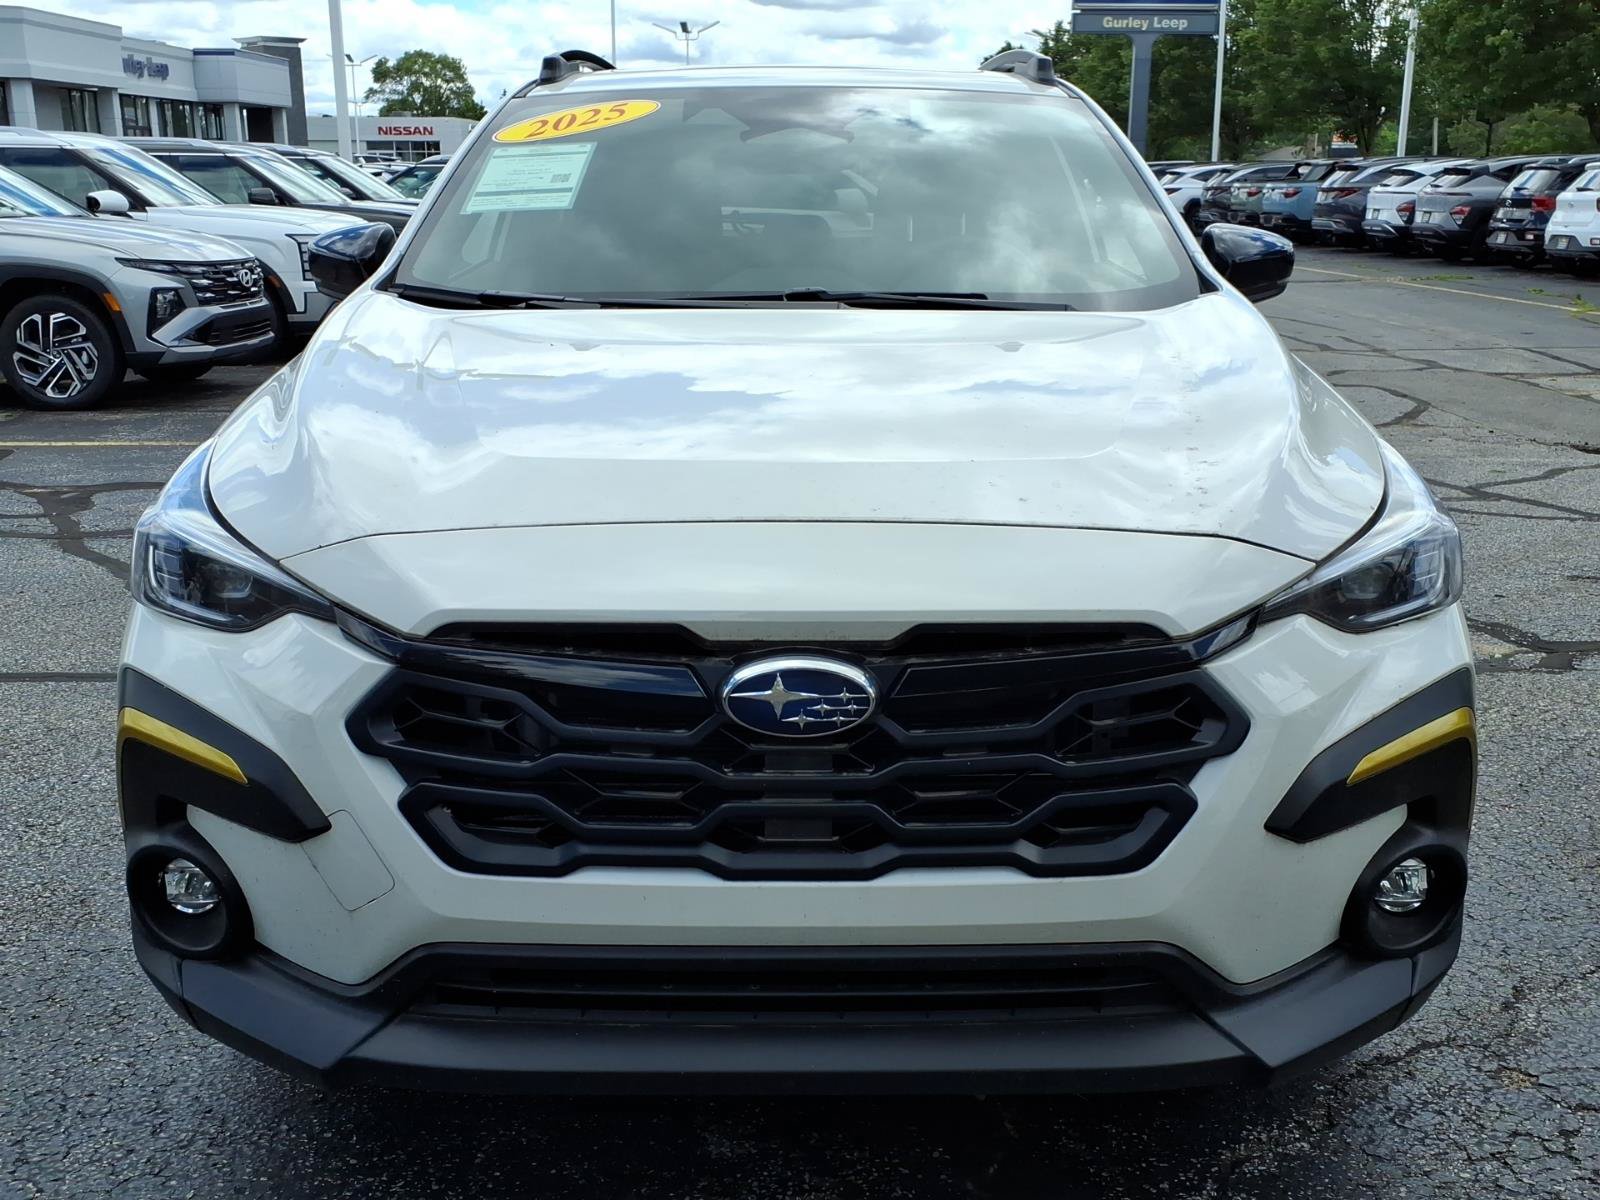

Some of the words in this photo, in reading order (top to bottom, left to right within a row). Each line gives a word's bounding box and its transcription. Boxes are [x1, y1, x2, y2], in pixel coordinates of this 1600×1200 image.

[1102, 16, 1149, 30] Gurley
[1153, 16, 1188, 30] Leep
[523, 102, 629, 139] 2025
[378, 126, 433, 136] NISSAN
